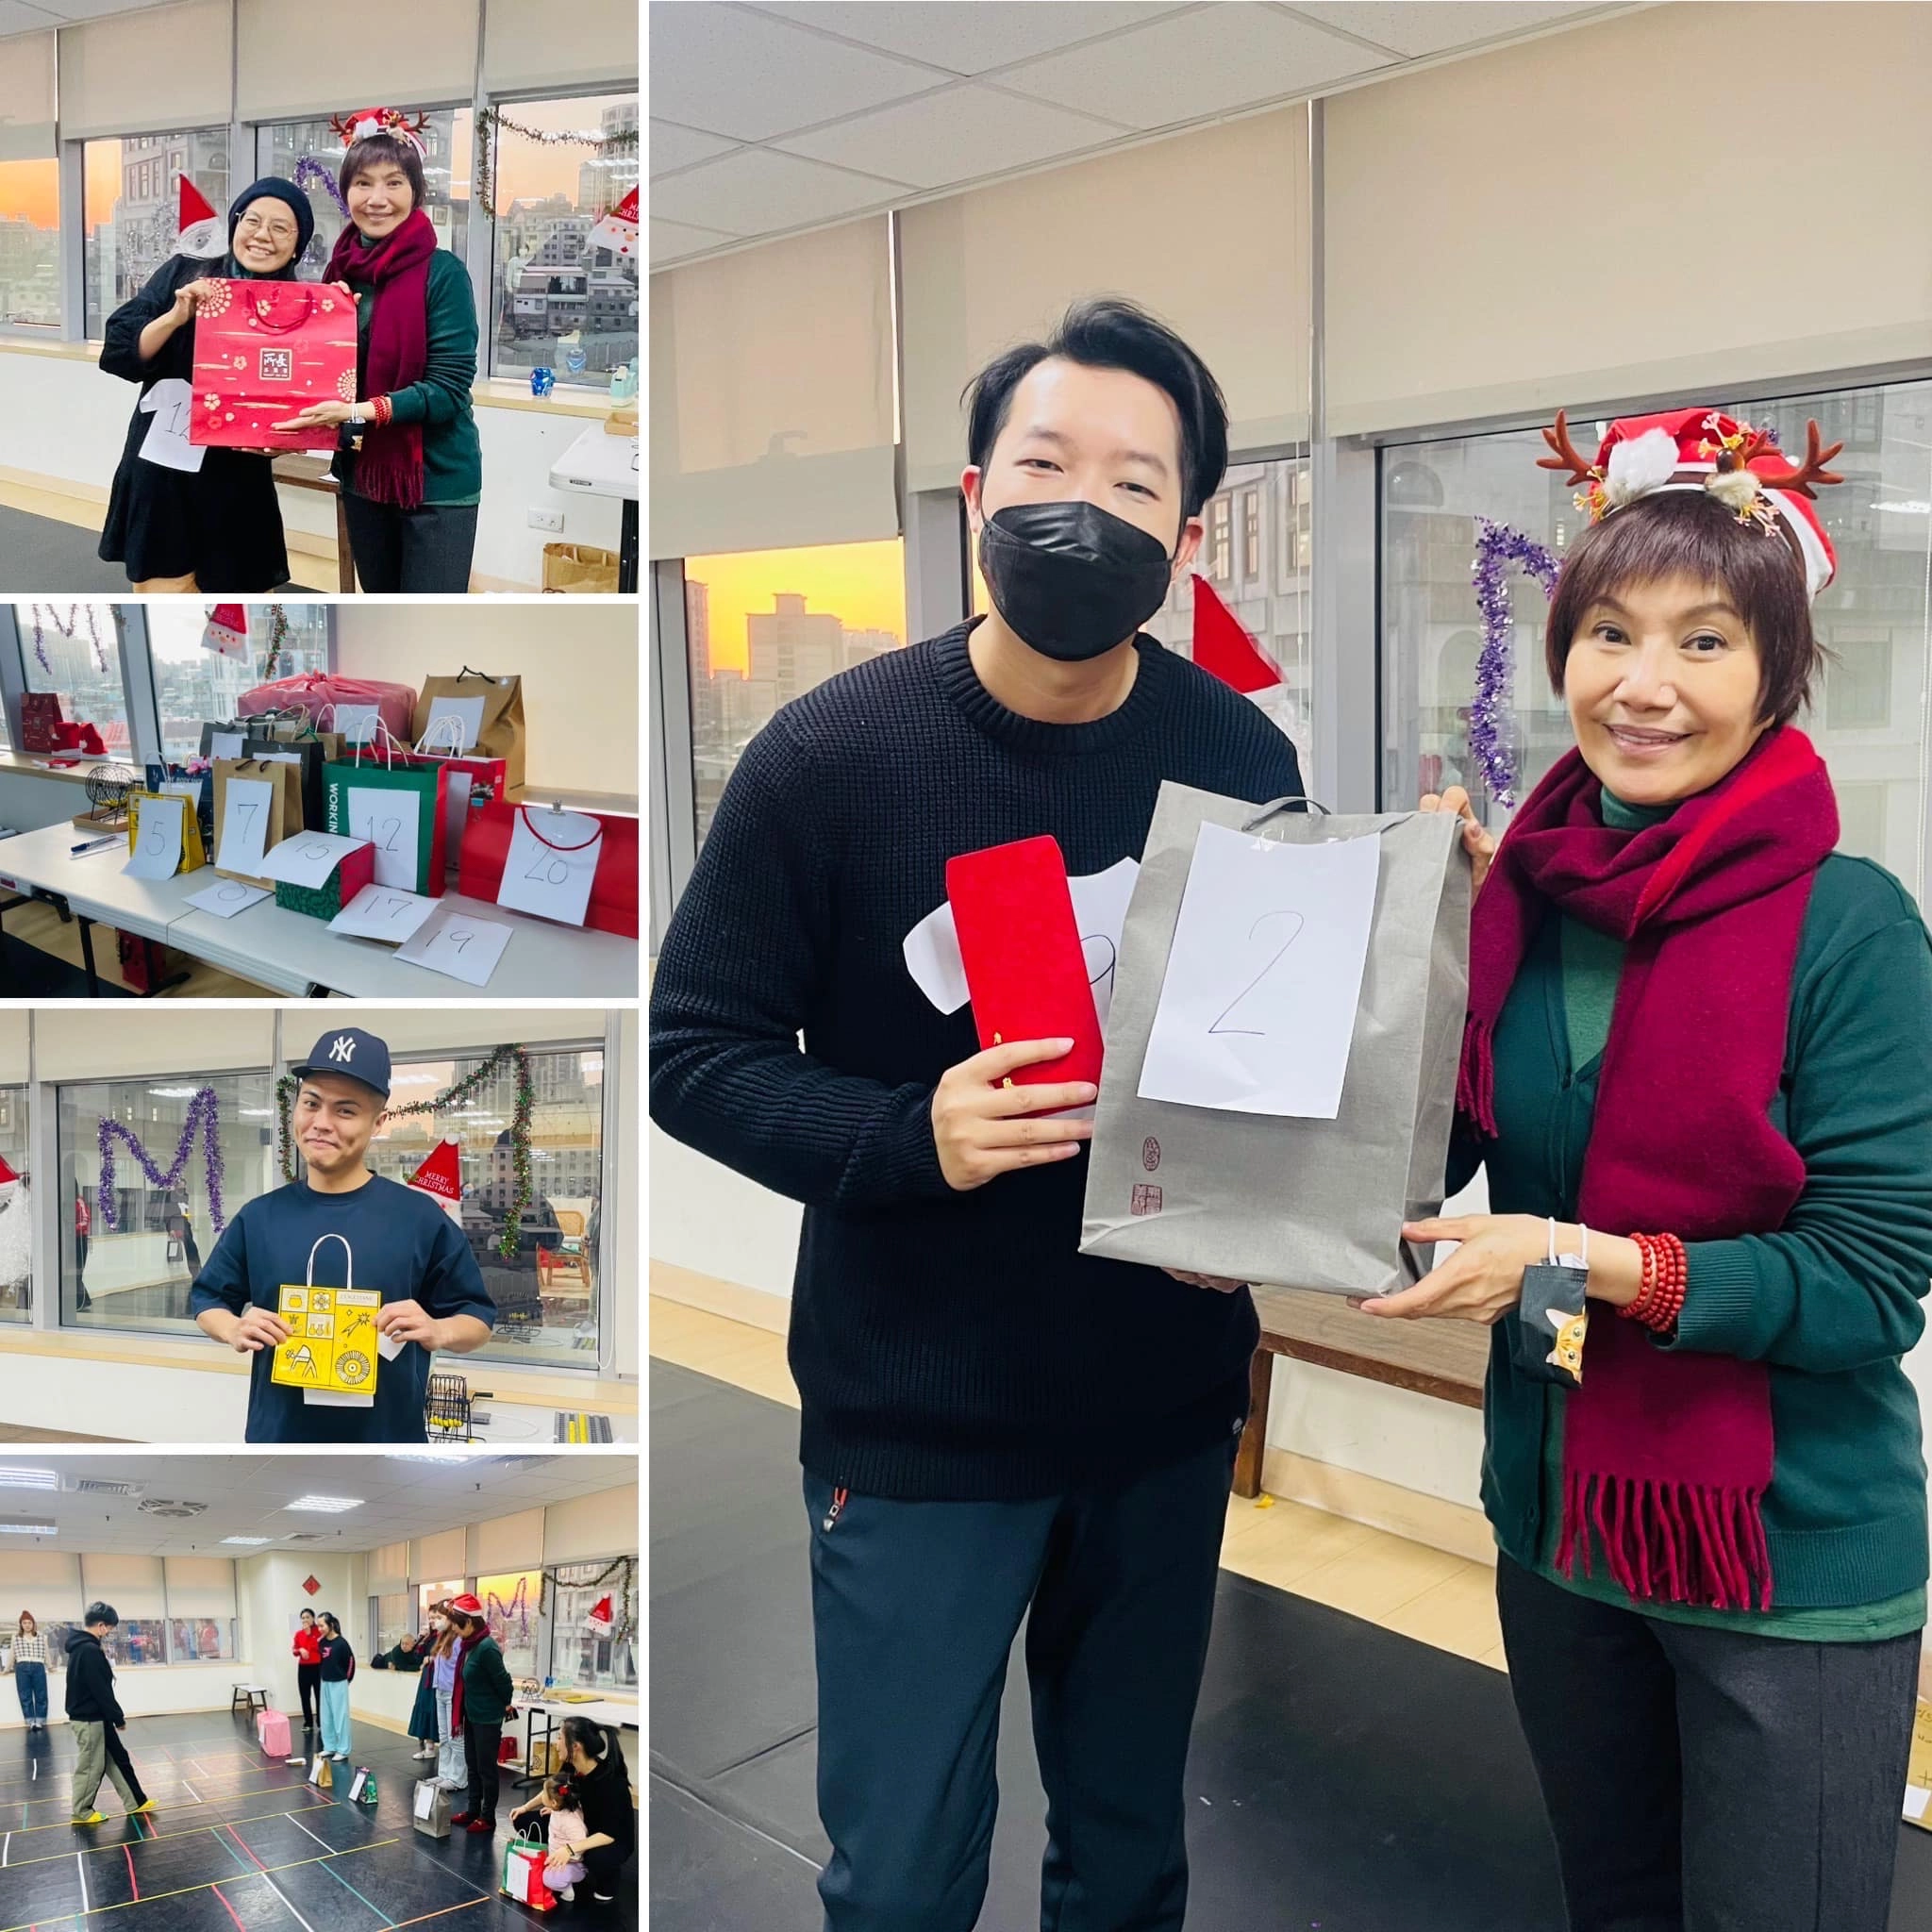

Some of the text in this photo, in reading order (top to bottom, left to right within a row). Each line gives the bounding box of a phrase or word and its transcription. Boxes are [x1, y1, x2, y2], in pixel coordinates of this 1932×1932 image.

[145, 821, 166, 857] 5
[237, 804, 258, 844] 7
[367, 815, 402, 852] 12
[295, 841, 333, 860] 15
[524, 838, 568, 885] 20
[364, 895, 413, 919] 17
[425, 930, 475, 954] 19
[1208, 910, 1305, 1036] 2
[328, 1035, 357, 1063] NY
[425, 1170, 450, 1185] MERRY
